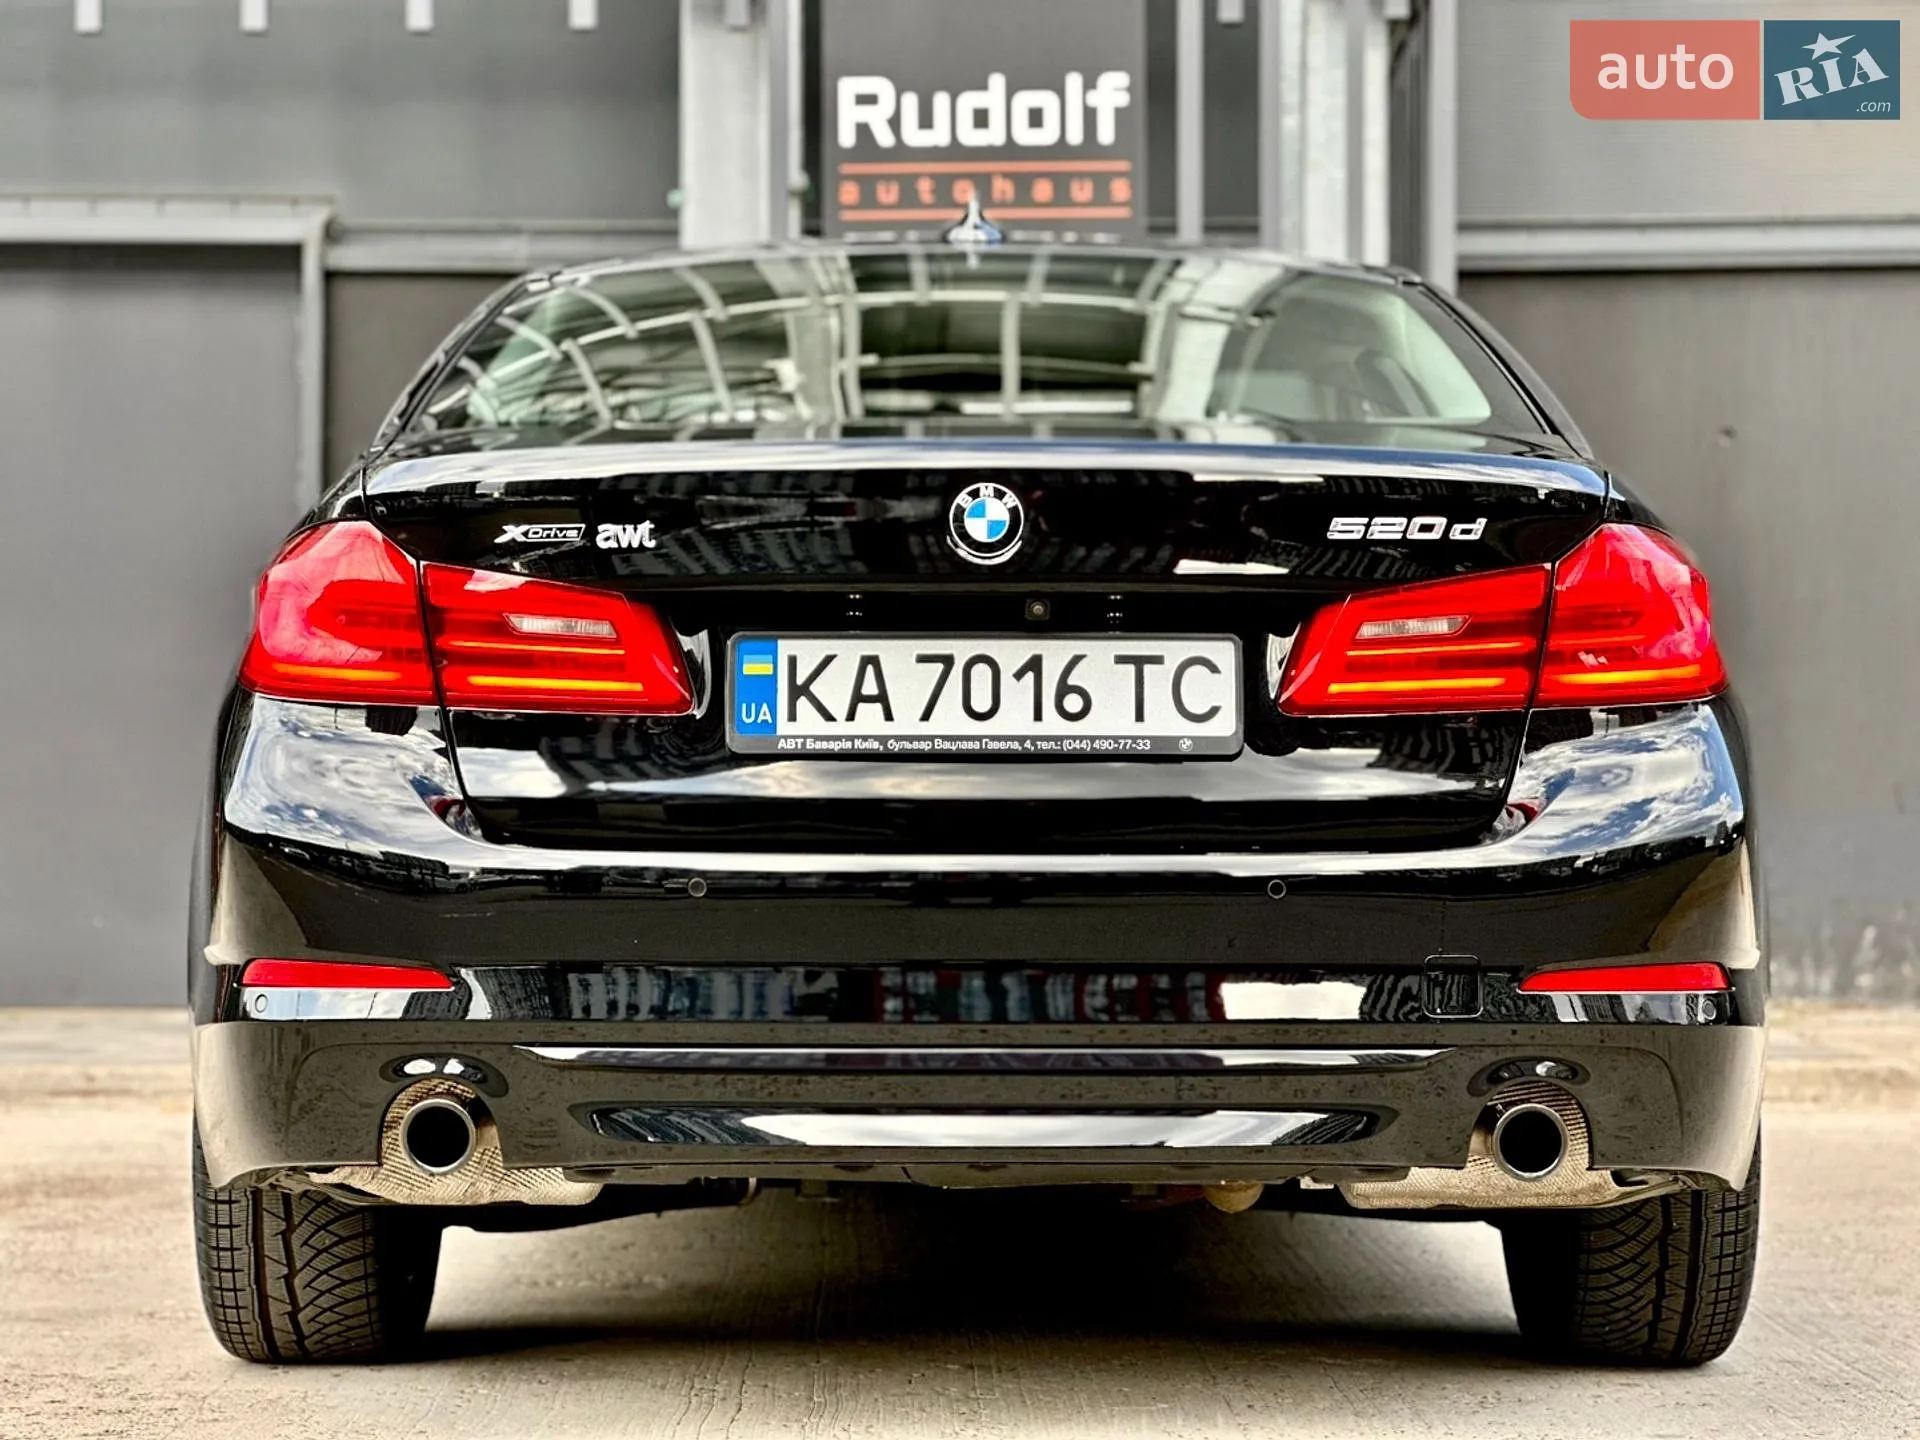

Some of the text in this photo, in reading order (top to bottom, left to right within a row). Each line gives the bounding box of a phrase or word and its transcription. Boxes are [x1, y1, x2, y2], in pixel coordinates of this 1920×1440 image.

[836, 70, 1131, 148] Rudolf
[838, 174, 1131, 205] autohaus
[956, 485, 1018, 509] BMW
[787, 653, 1222, 723] KA 7016 TC
[741, 702, 773, 723] UA
[887, 738, 932, 751] бульвар
[934, 738, 981, 751] Вацлава
[982, 738, 1022, 751] Гавела,
[1023, 738, 1034, 751] 4,
[1062, 738, 1091, 751] (044)
[1092, 738, 1151, 750] 490-77-33
